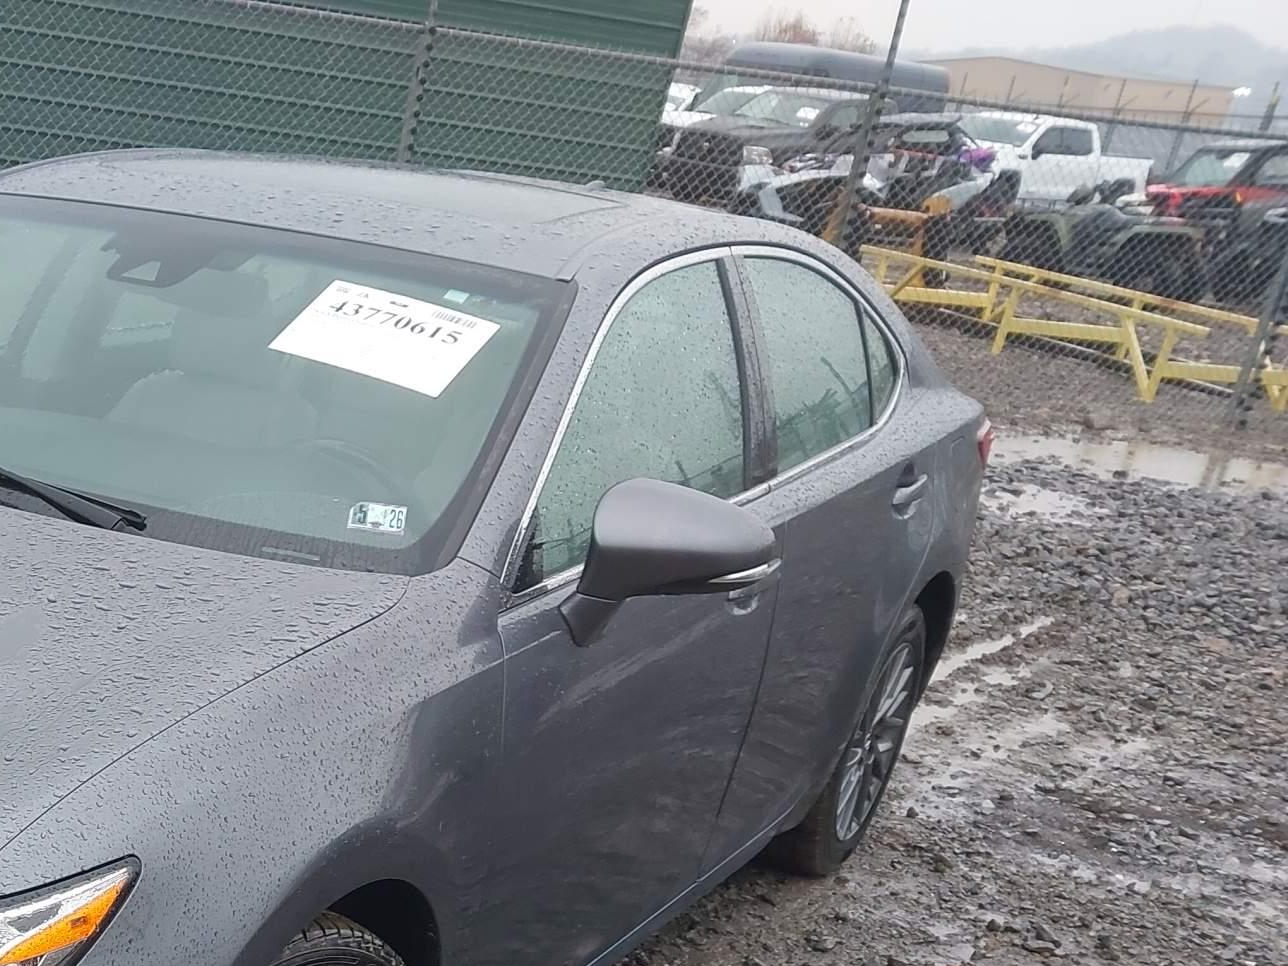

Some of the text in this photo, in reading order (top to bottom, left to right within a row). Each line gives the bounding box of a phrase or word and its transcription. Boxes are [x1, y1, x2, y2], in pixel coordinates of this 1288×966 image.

[328, 300, 463, 344] 43770615
[354, 503, 404, 529] 5 26
